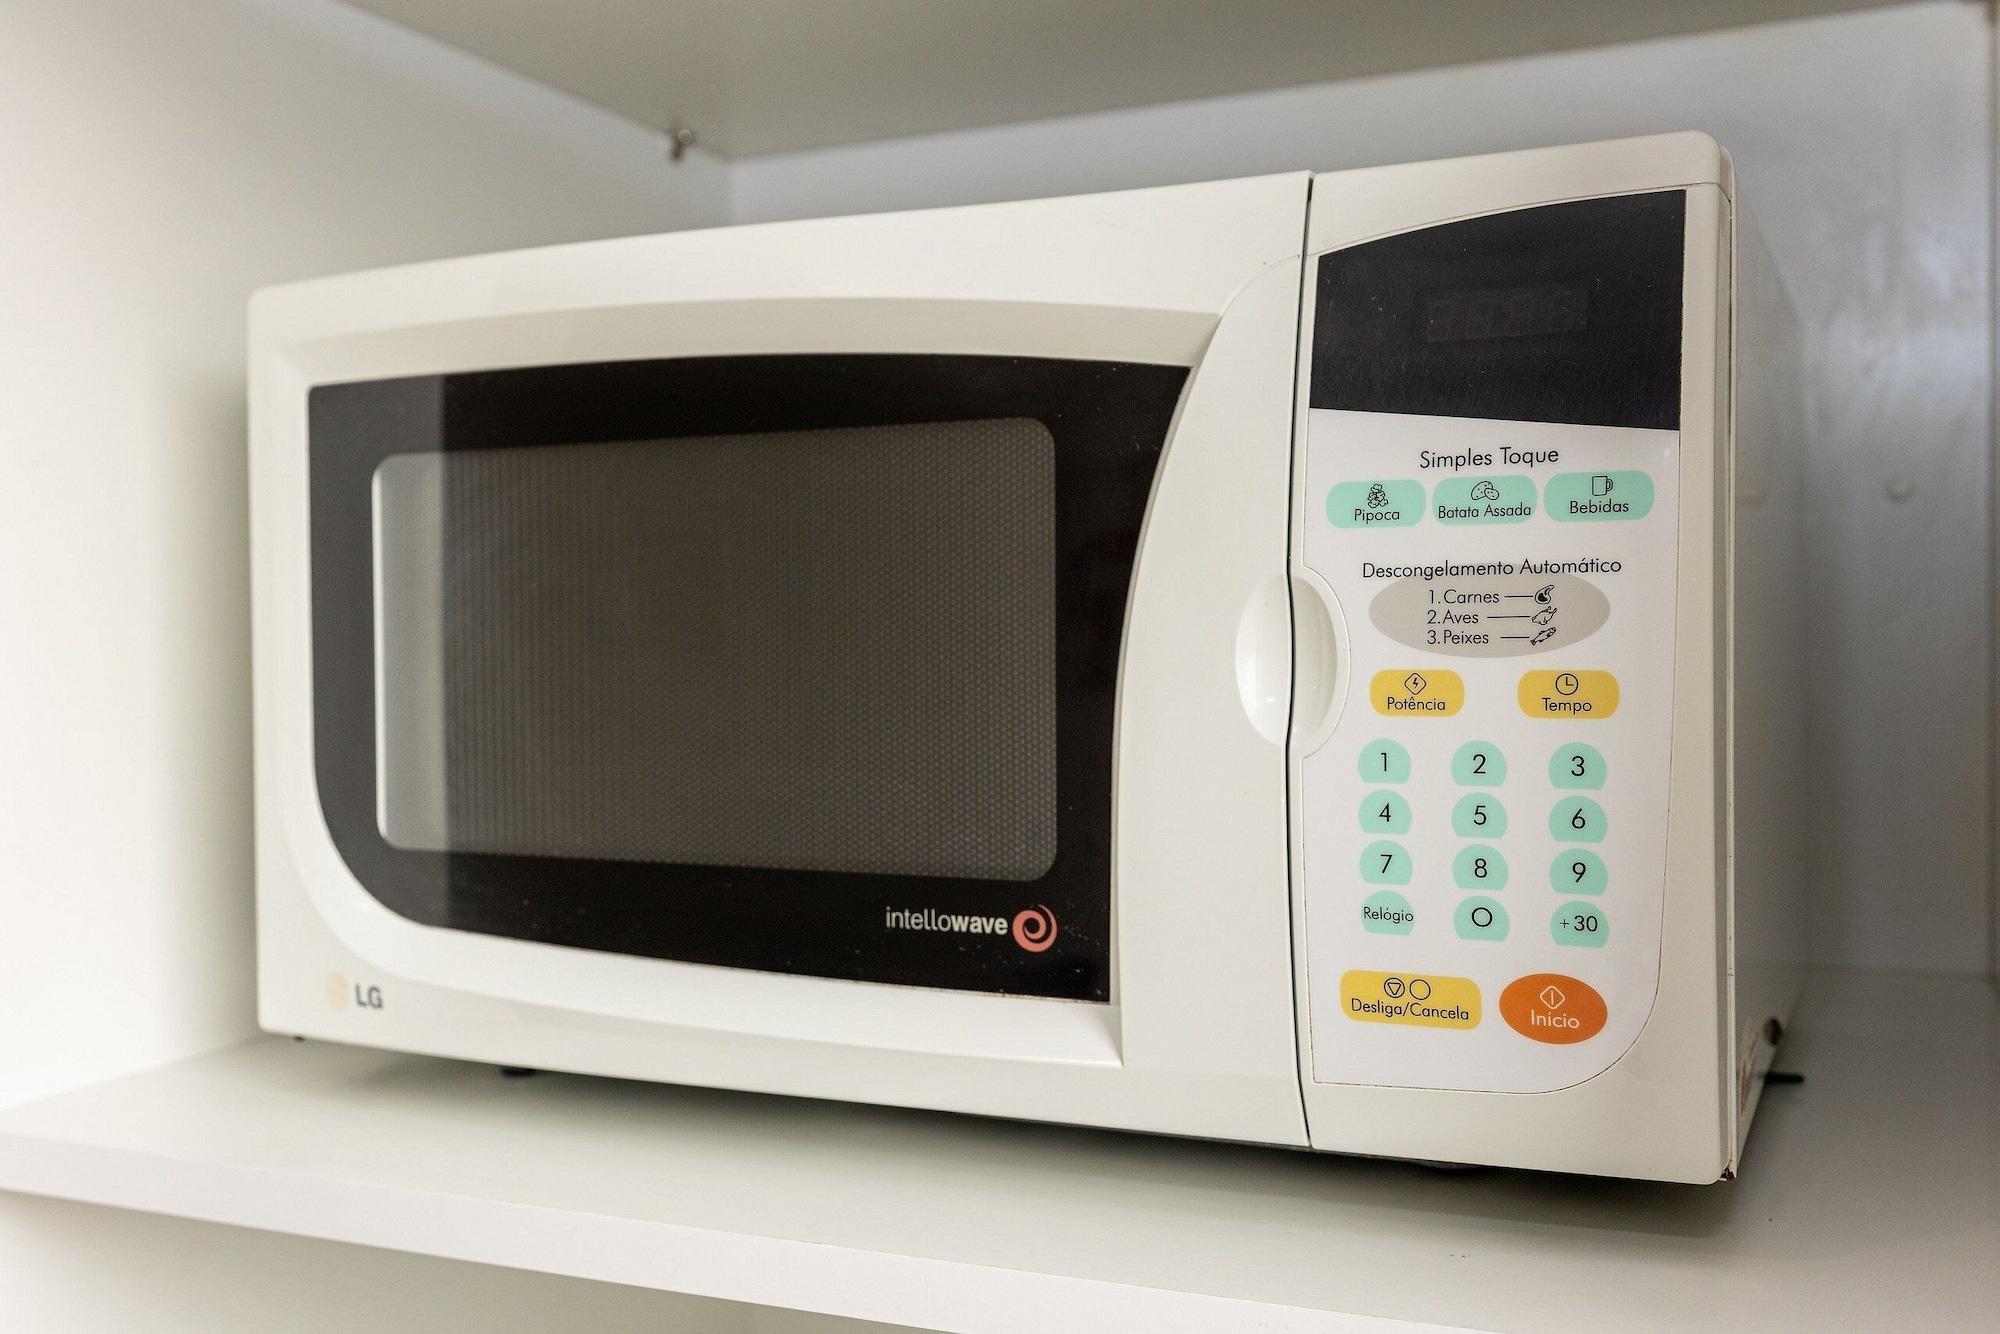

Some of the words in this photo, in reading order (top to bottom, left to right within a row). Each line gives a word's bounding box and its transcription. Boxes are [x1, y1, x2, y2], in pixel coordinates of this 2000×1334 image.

[1419, 449, 1492, 471] Simples
[1499, 447, 1559, 467] Toque
[1354, 508, 1401, 523] Pipoca
[1438, 506, 1479, 519] Batata
[1484, 503, 1532, 518] Assada
[1569, 500, 1630, 514] Bebidas
[1362, 562, 1514, 580] Descongelamento
[1519, 558, 1622, 574] Automático
[1387, 697, 1446, 712] Potência
[1542, 698, 1592, 714] Tempo
[1380, 752, 1389, 772] 1
[1472, 754, 1487, 774] 2
[1571, 756, 1585, 777] 3
[1379, 803, 1392, 822] 4
[1473, 806, 1487, 826] 5
[1571, 808, 1586, 829] 6
[1380, 854, 1392, 873] 7
[1474, 858, 1488, 878] 8
[1572, 862, 1587, 882] 9
[885, 906, 1008, 935] intellowave
[1363, 907, 1414, 923] Relógio
[354, 983, 383, 1009] LG
[1351, 998, 1469, 1021] Desliga/Cancela
[1530, 1010, 1579, 1029] Início
